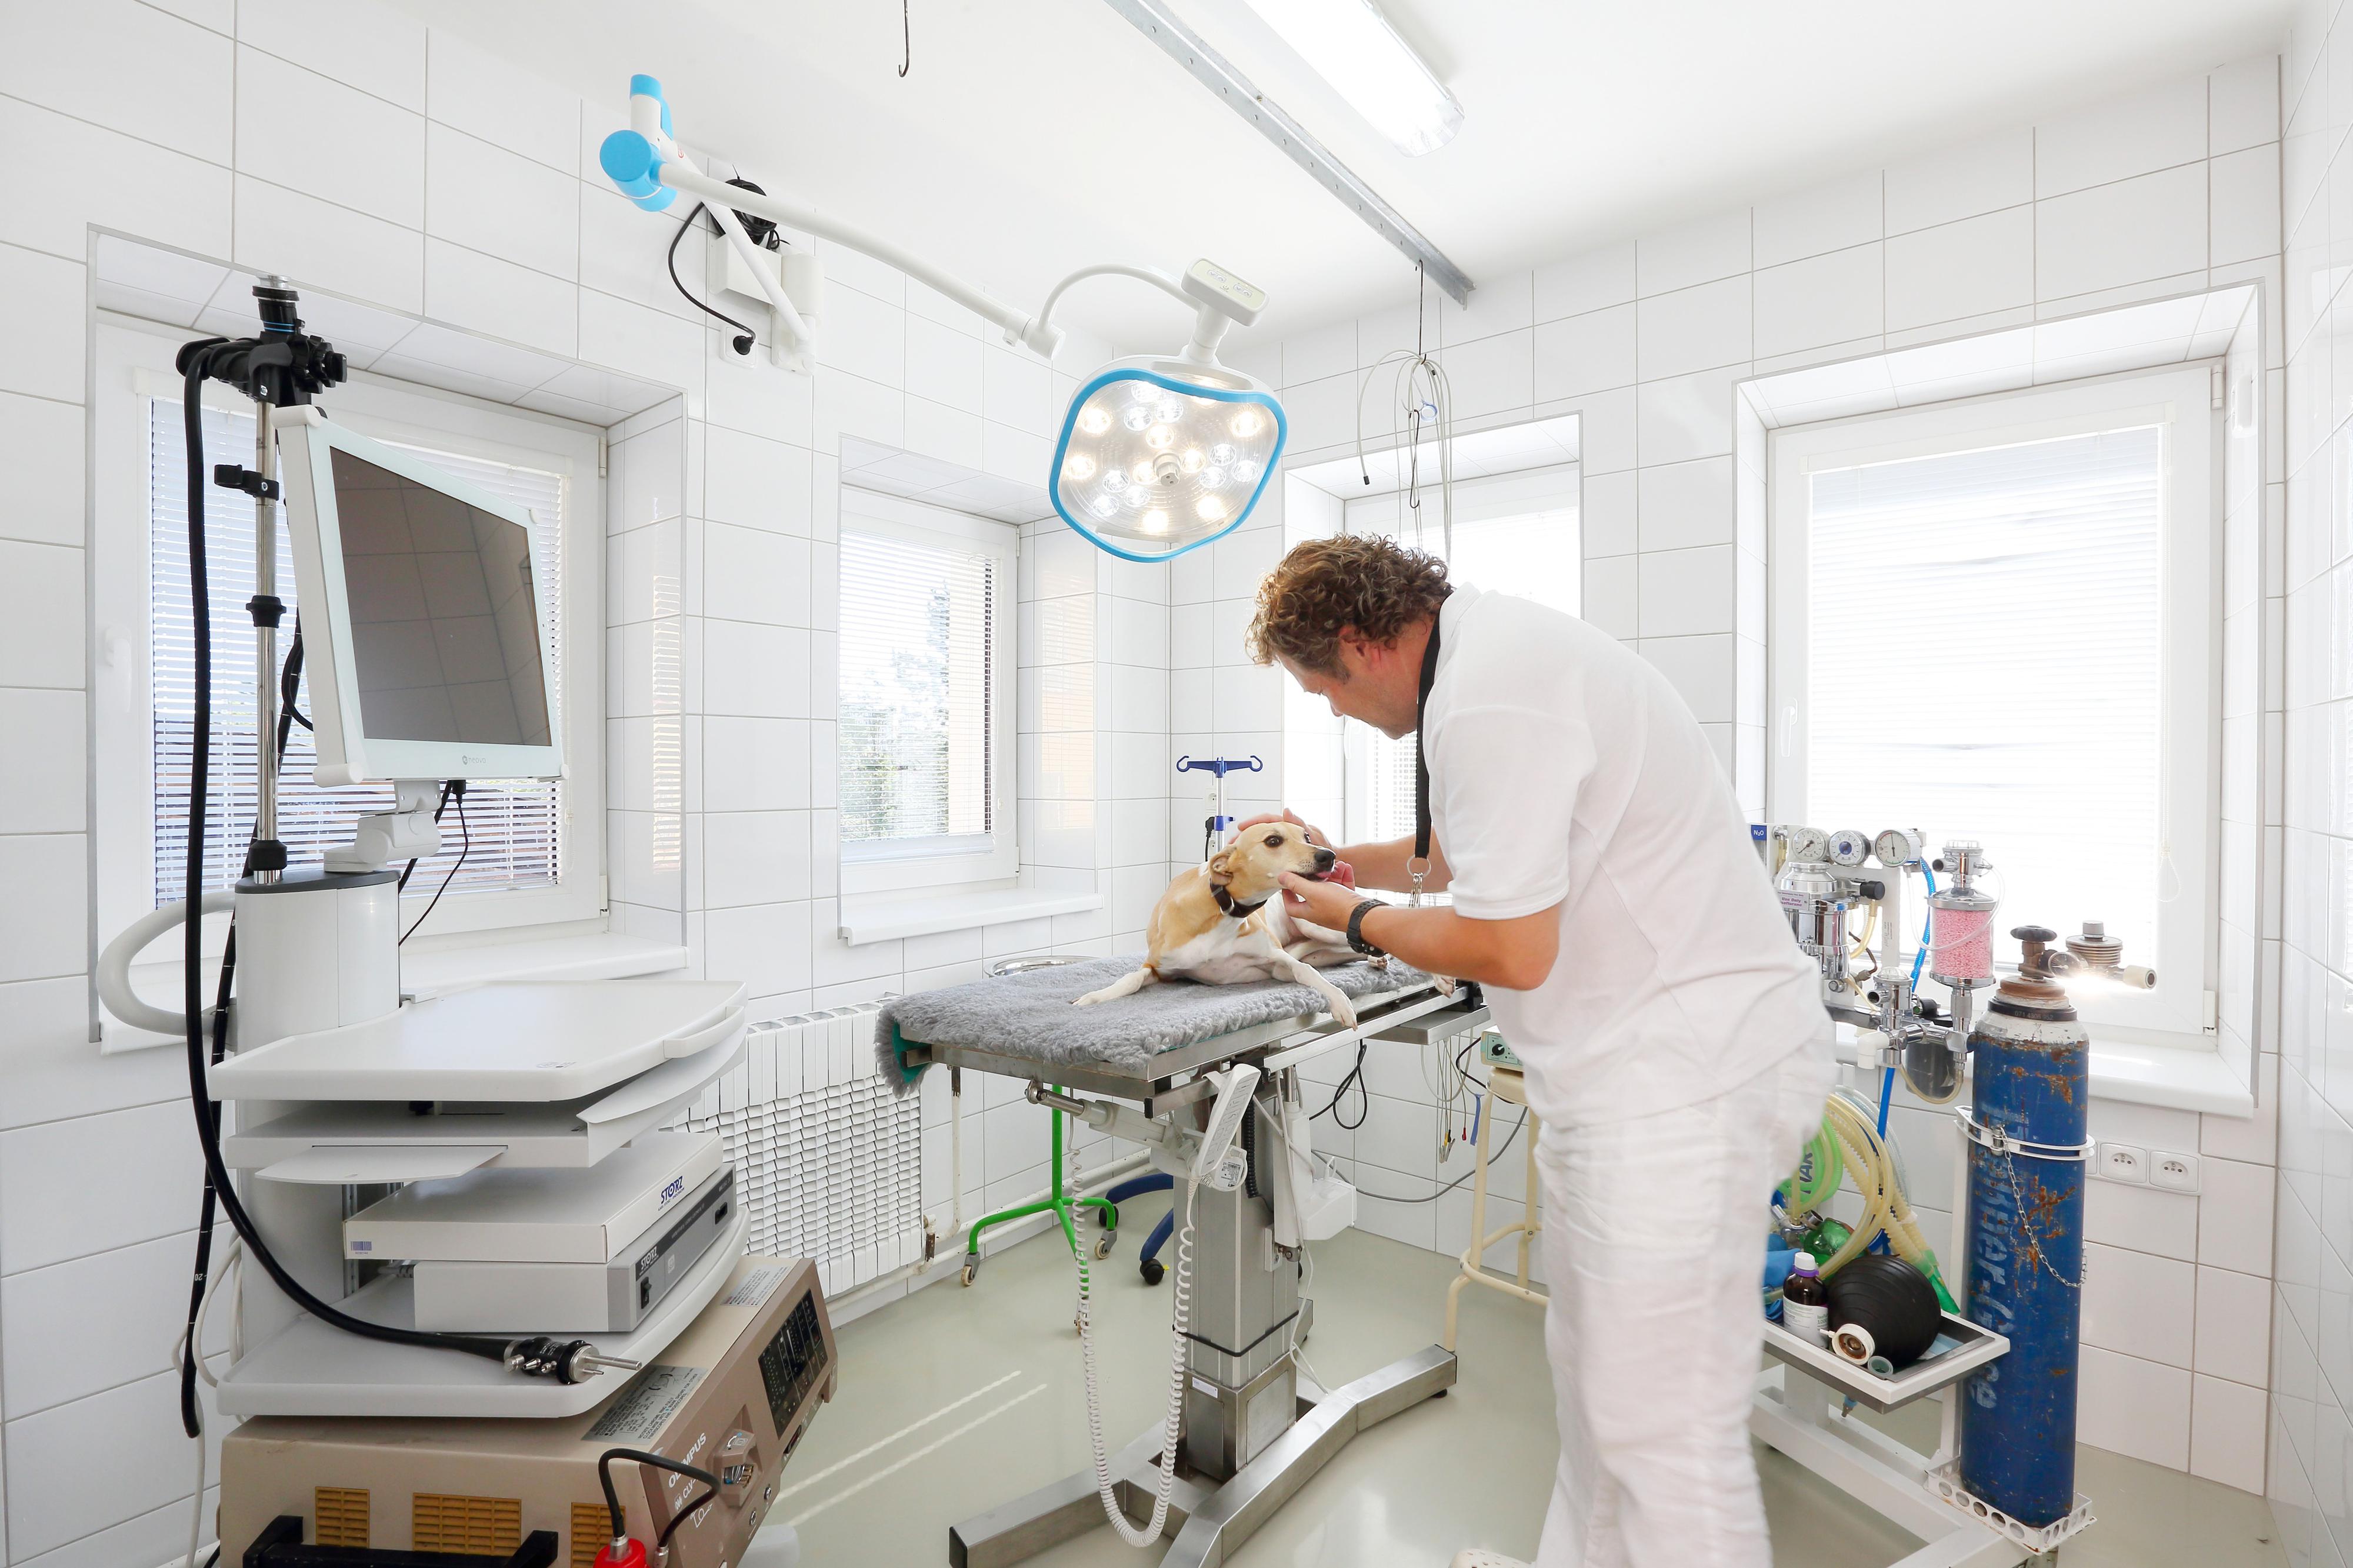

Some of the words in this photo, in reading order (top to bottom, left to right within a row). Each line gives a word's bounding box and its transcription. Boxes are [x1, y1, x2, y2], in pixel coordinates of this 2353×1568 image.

[661, 1175, 683, 1205] STORZ
[641, 1246, 657, 1270] STORZ
[668, 1432, 706, 1488] OLMPUS
